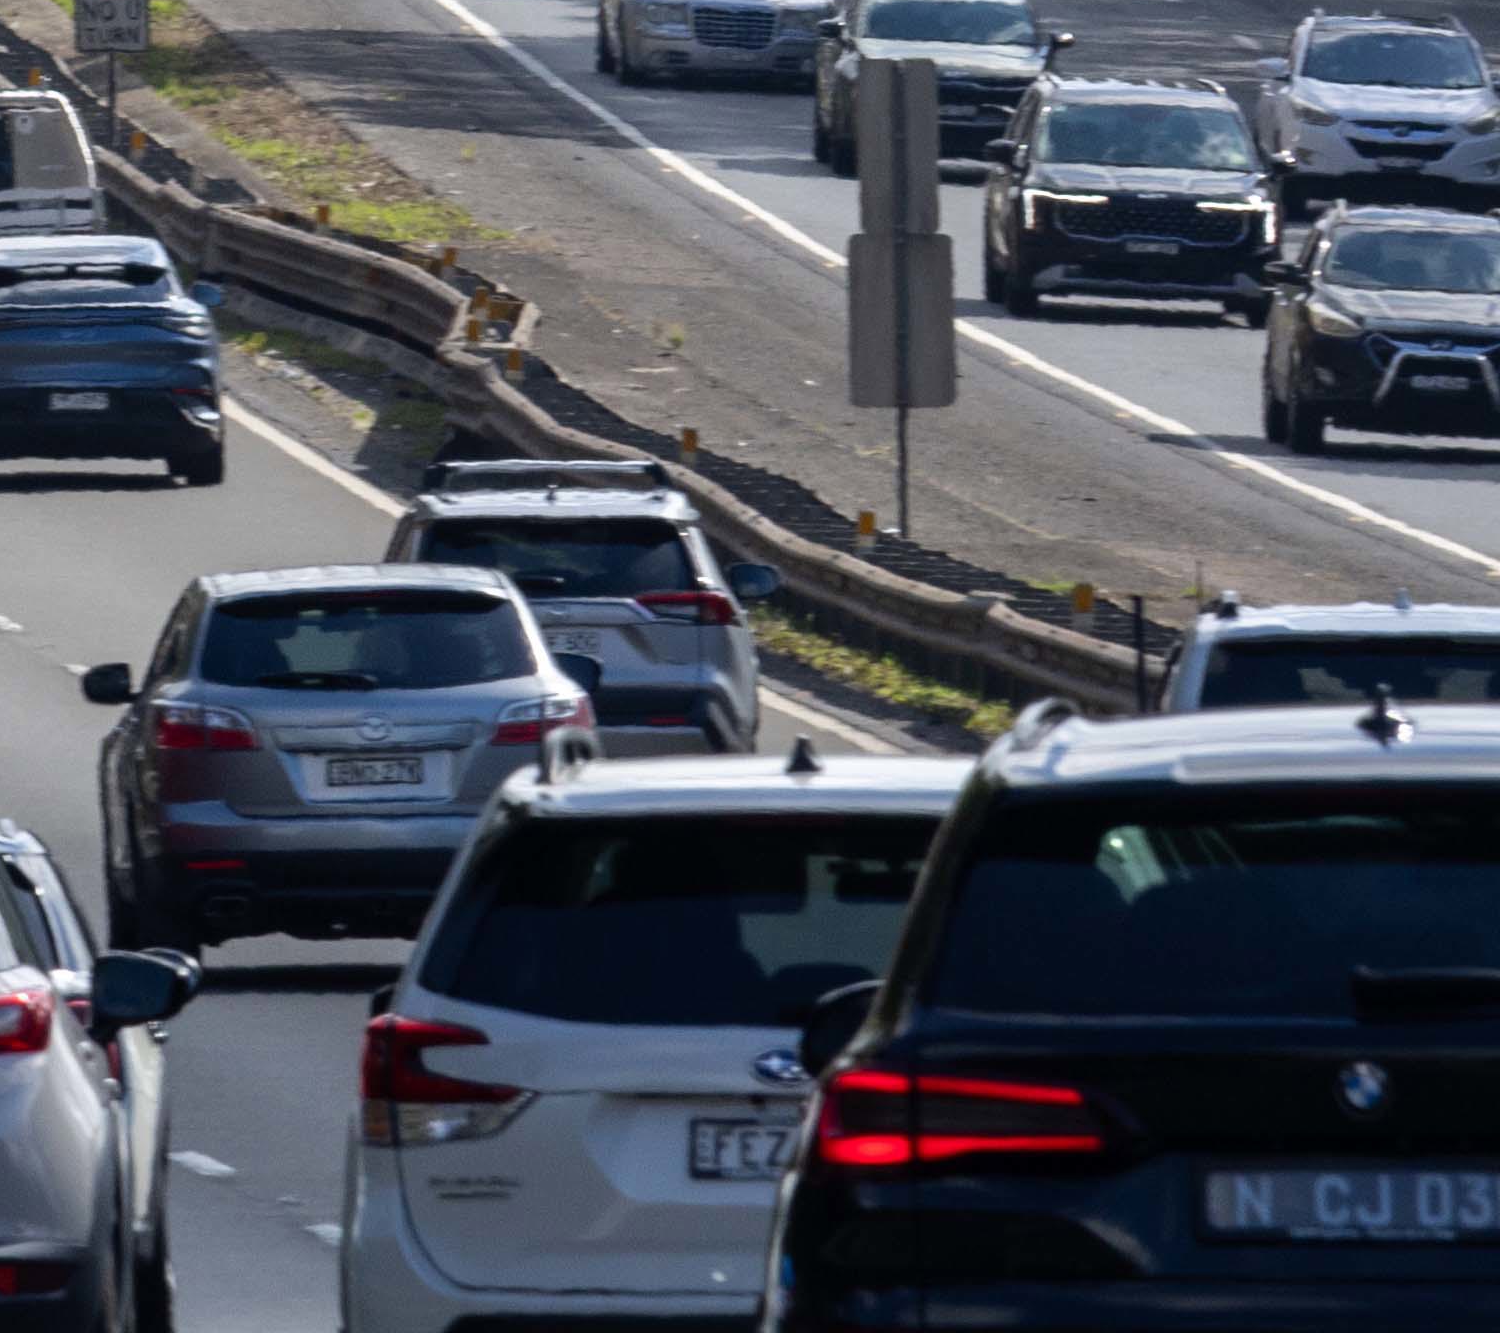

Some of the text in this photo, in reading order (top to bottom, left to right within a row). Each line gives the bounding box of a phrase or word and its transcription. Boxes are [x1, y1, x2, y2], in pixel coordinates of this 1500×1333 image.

[83, 0, 141, 22] NO U
[83, 26, 141, 44] TURN
